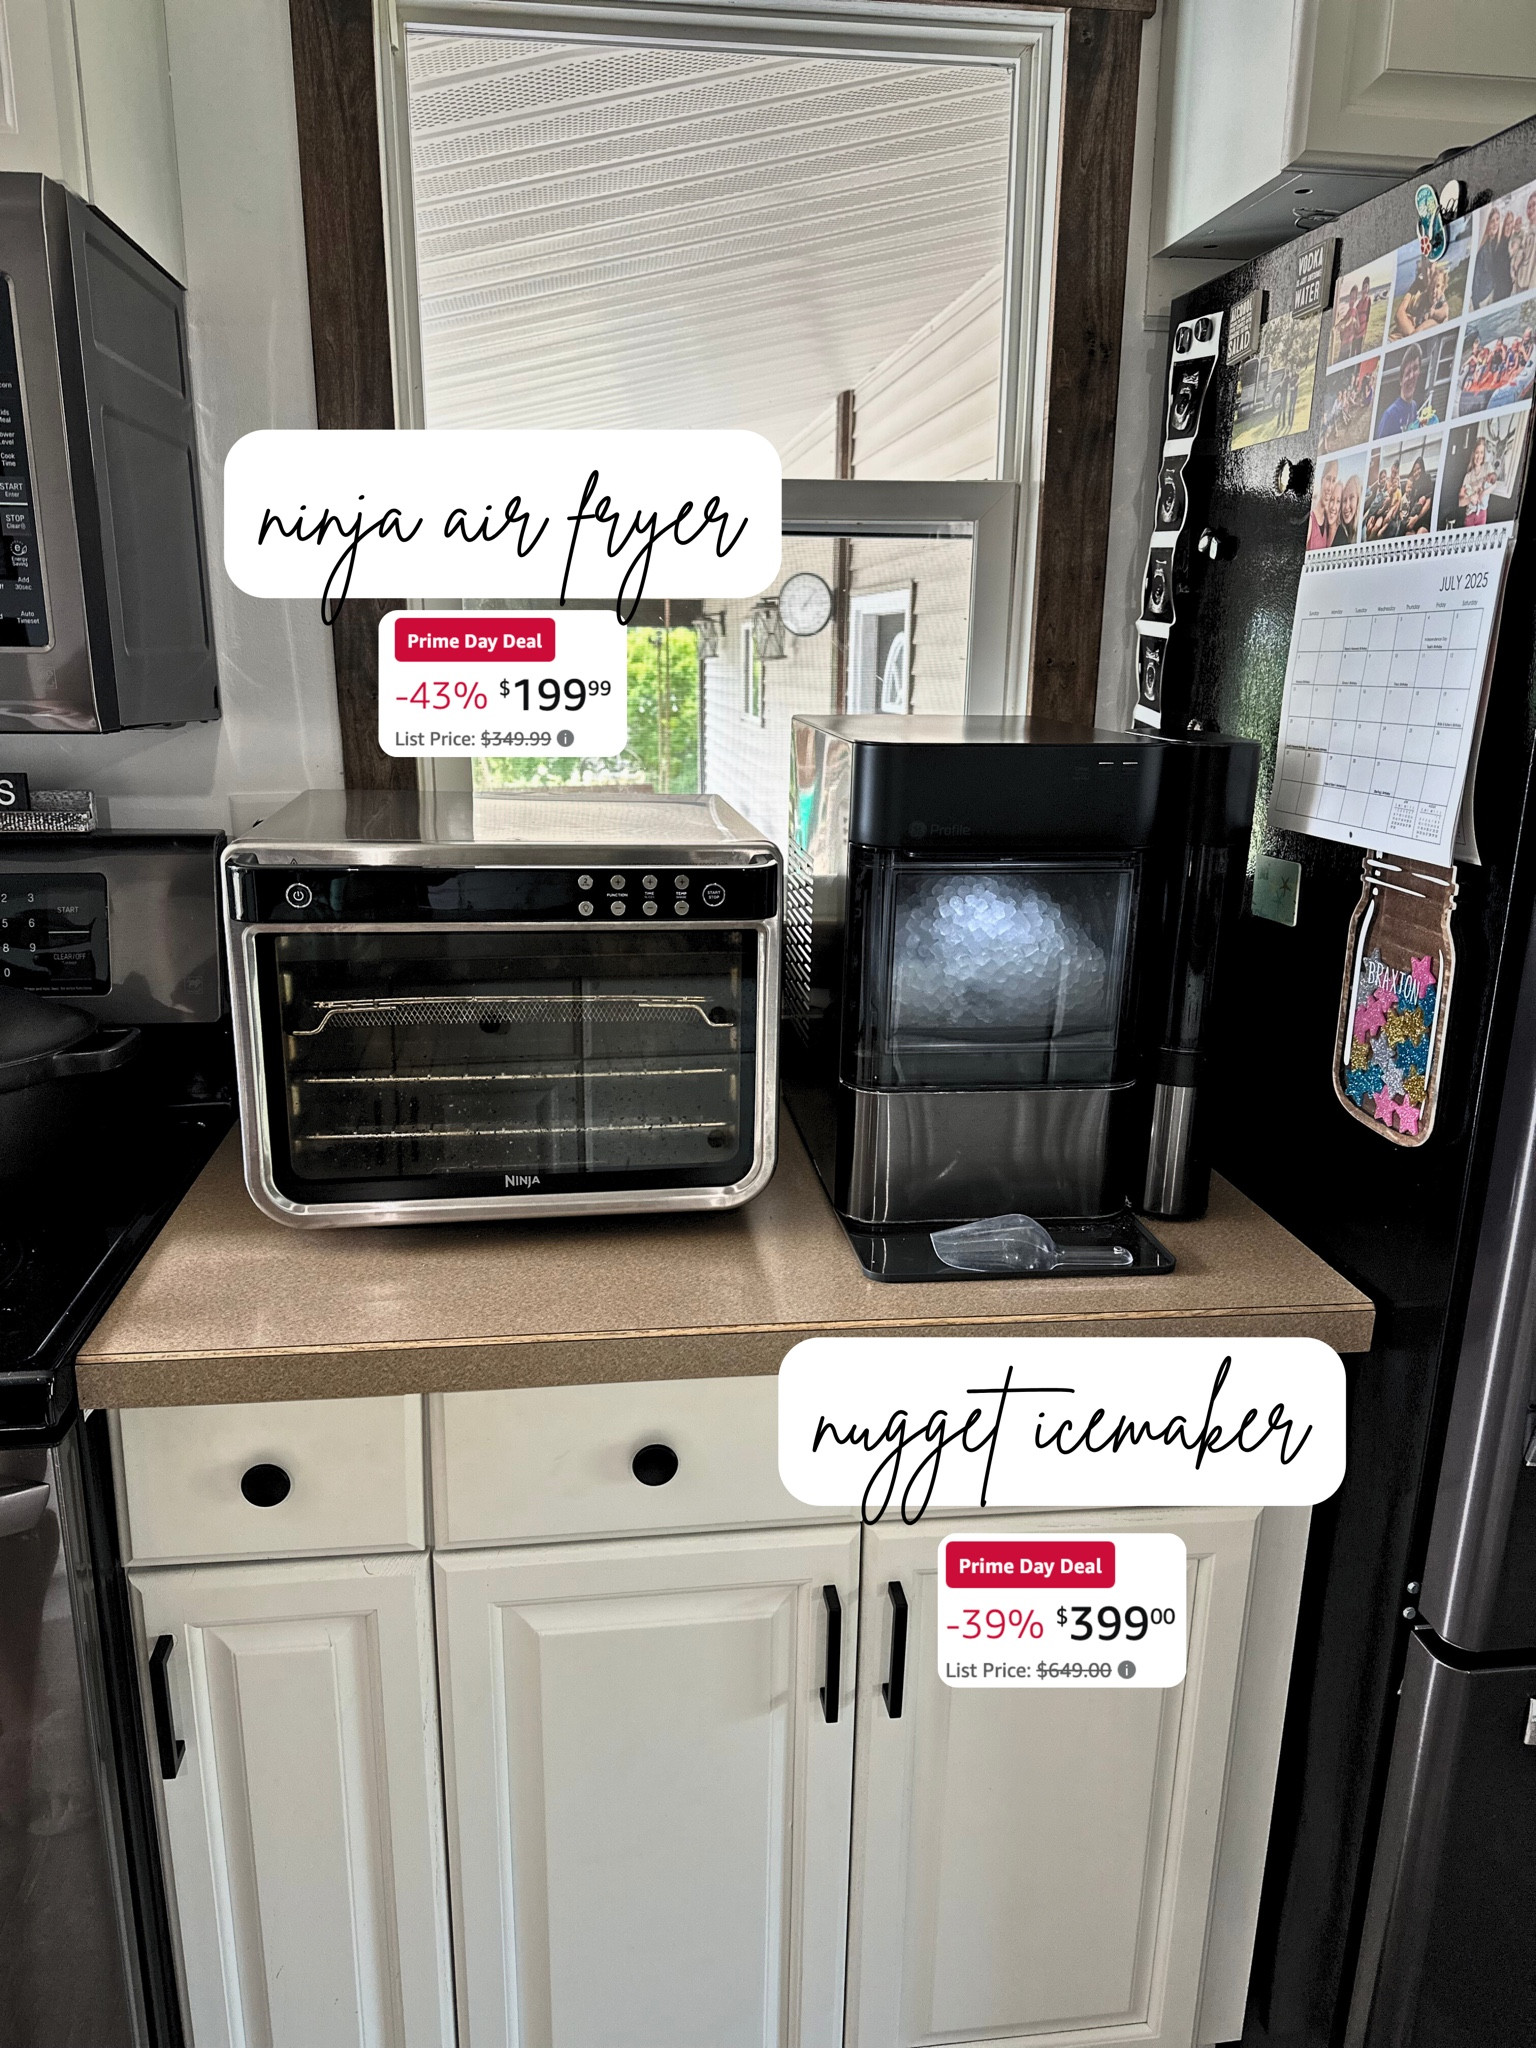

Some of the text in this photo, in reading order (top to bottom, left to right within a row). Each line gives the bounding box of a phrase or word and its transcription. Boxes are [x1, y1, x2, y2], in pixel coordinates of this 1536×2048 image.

[1299, 247, 1323, 276] VODKA
[1294, 281, 1320, 309] WATER
[1228, 330, 1250, 358] SALAD
[5, 514, 25, 522] STOP
[1439, 571, 1489, 592] JULY 2025
[930, 824, 972, 836] Profile
[1, 893, 35, 903] 2 3
[2, 918, 35, 928] 5 6
[2, 942, 37, 953] 8 9
[53, 953, 86, 961] CLEAR/OFF
[3, 967, 11, 978] 0
[1367, 960, 1420, 1006] BRAXTON
[505, 1174, 541, 1189] NINJA
